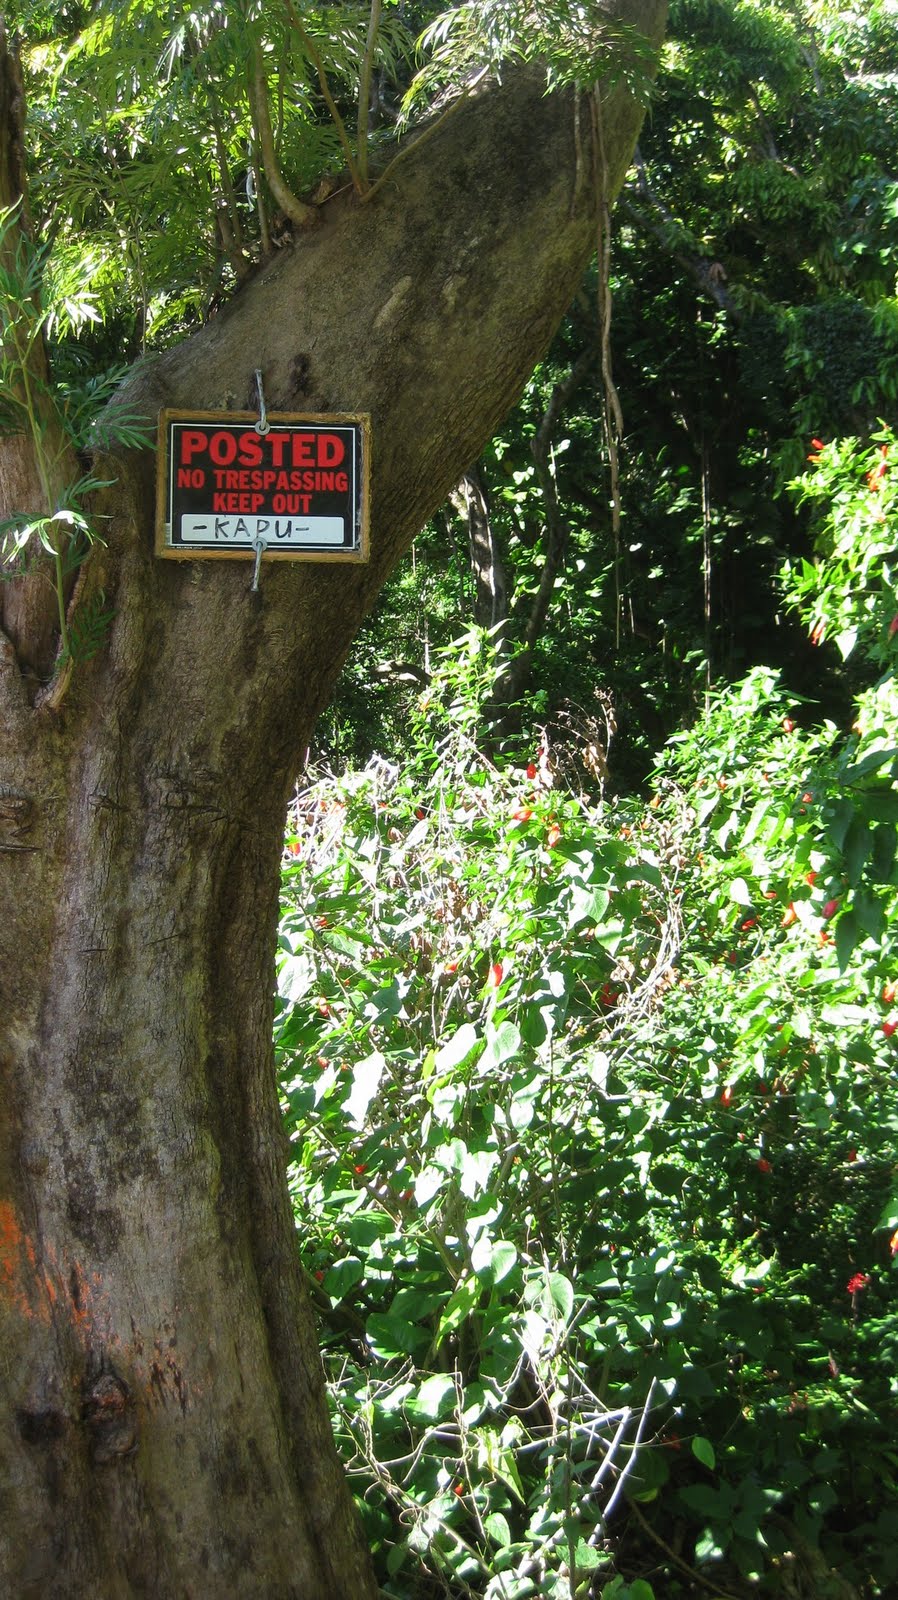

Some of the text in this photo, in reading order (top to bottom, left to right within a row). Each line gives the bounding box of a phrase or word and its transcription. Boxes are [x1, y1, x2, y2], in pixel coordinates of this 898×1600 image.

[181, 431, 345, 468] POSTED
[178, 469, 348, 492] NO TRESPASSING
[213, 493, 312, 514] KEEP OUT
